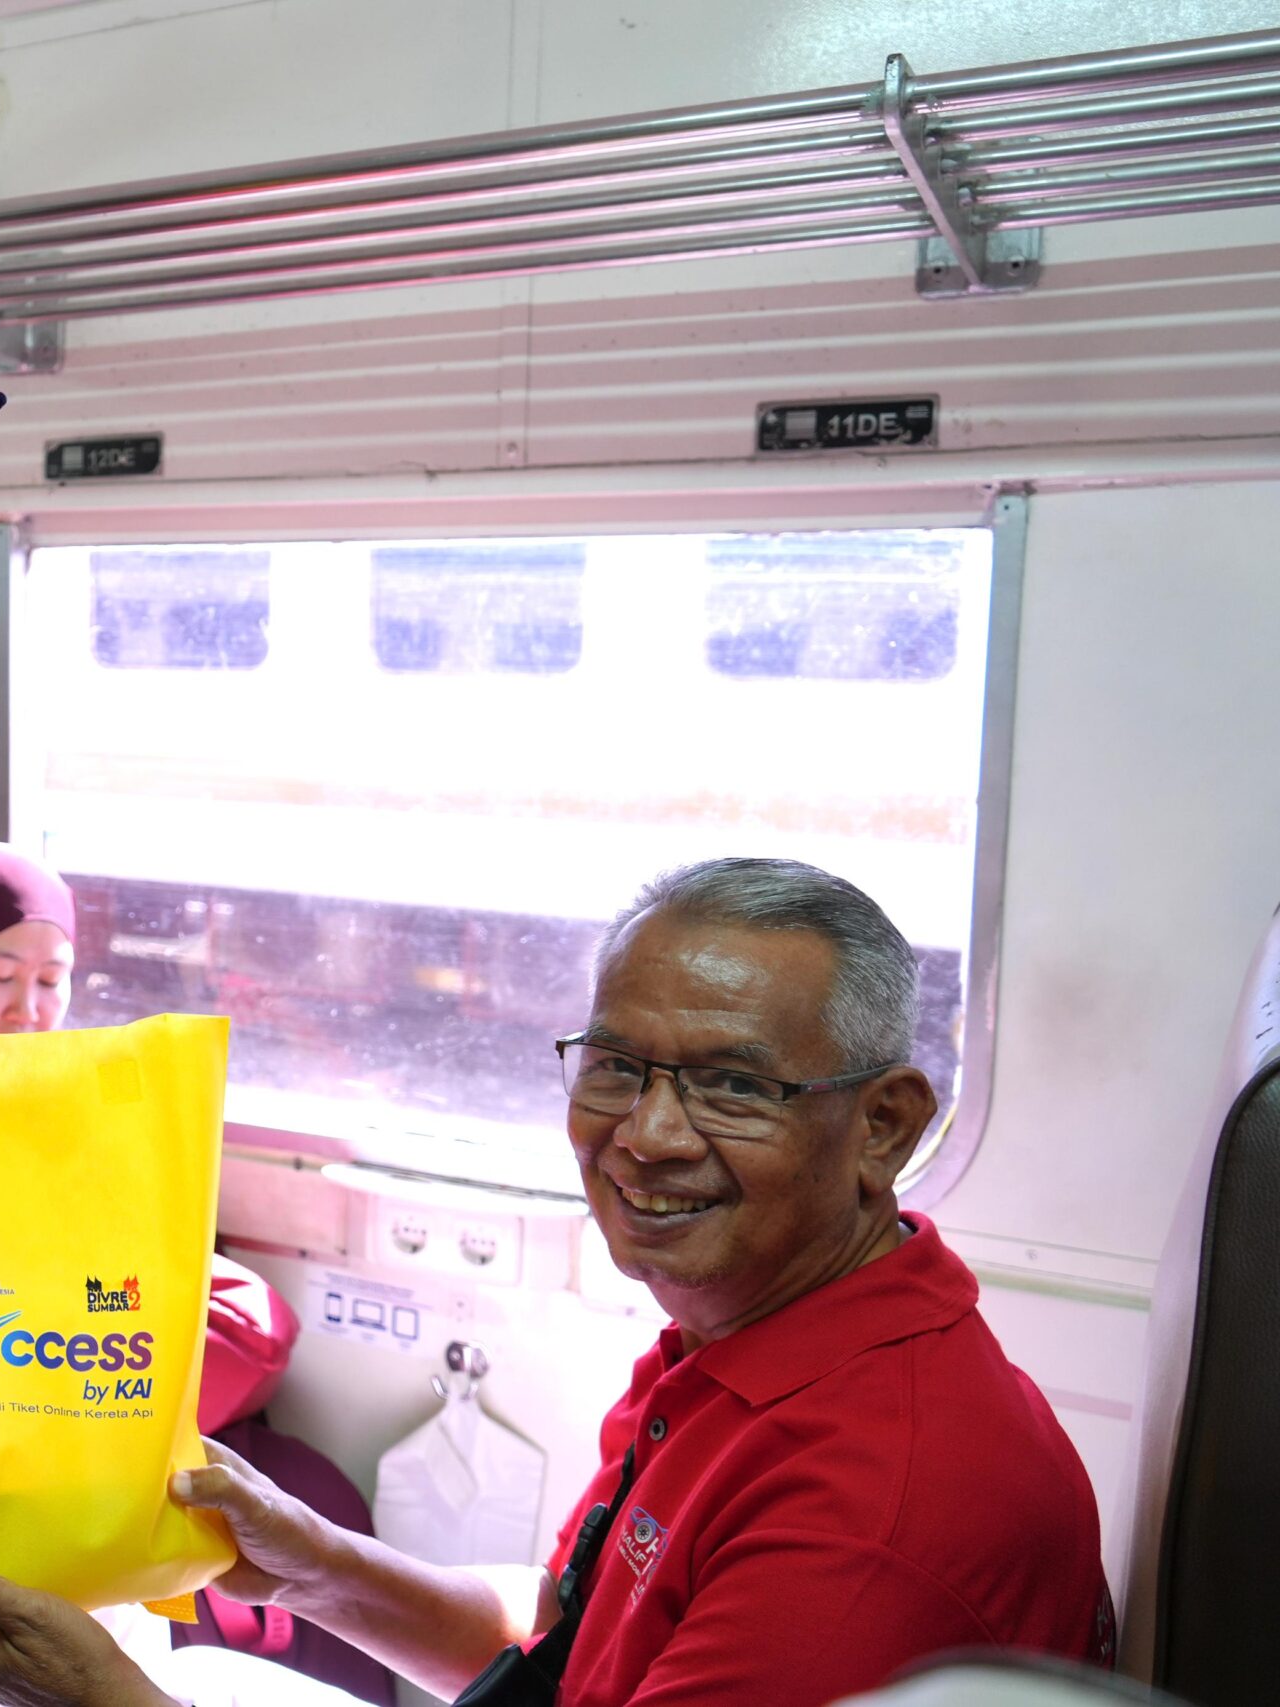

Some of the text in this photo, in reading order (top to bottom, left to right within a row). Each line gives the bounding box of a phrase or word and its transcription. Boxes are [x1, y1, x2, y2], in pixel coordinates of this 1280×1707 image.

[827, 412, 899, 438] 11DE
[87, 1289, 141, 1311] DIVRE 2
[87, 1303, 129, 1313] SUMBAR
[83, 1377, 153, 1406] by KAI
[8, 1402, 40, 1414] Tiket
[43, 1404, 81, 1418] Online
[84, 1409, 129, 1419] Kereta
[131, 1408, 154, 1419] Api
